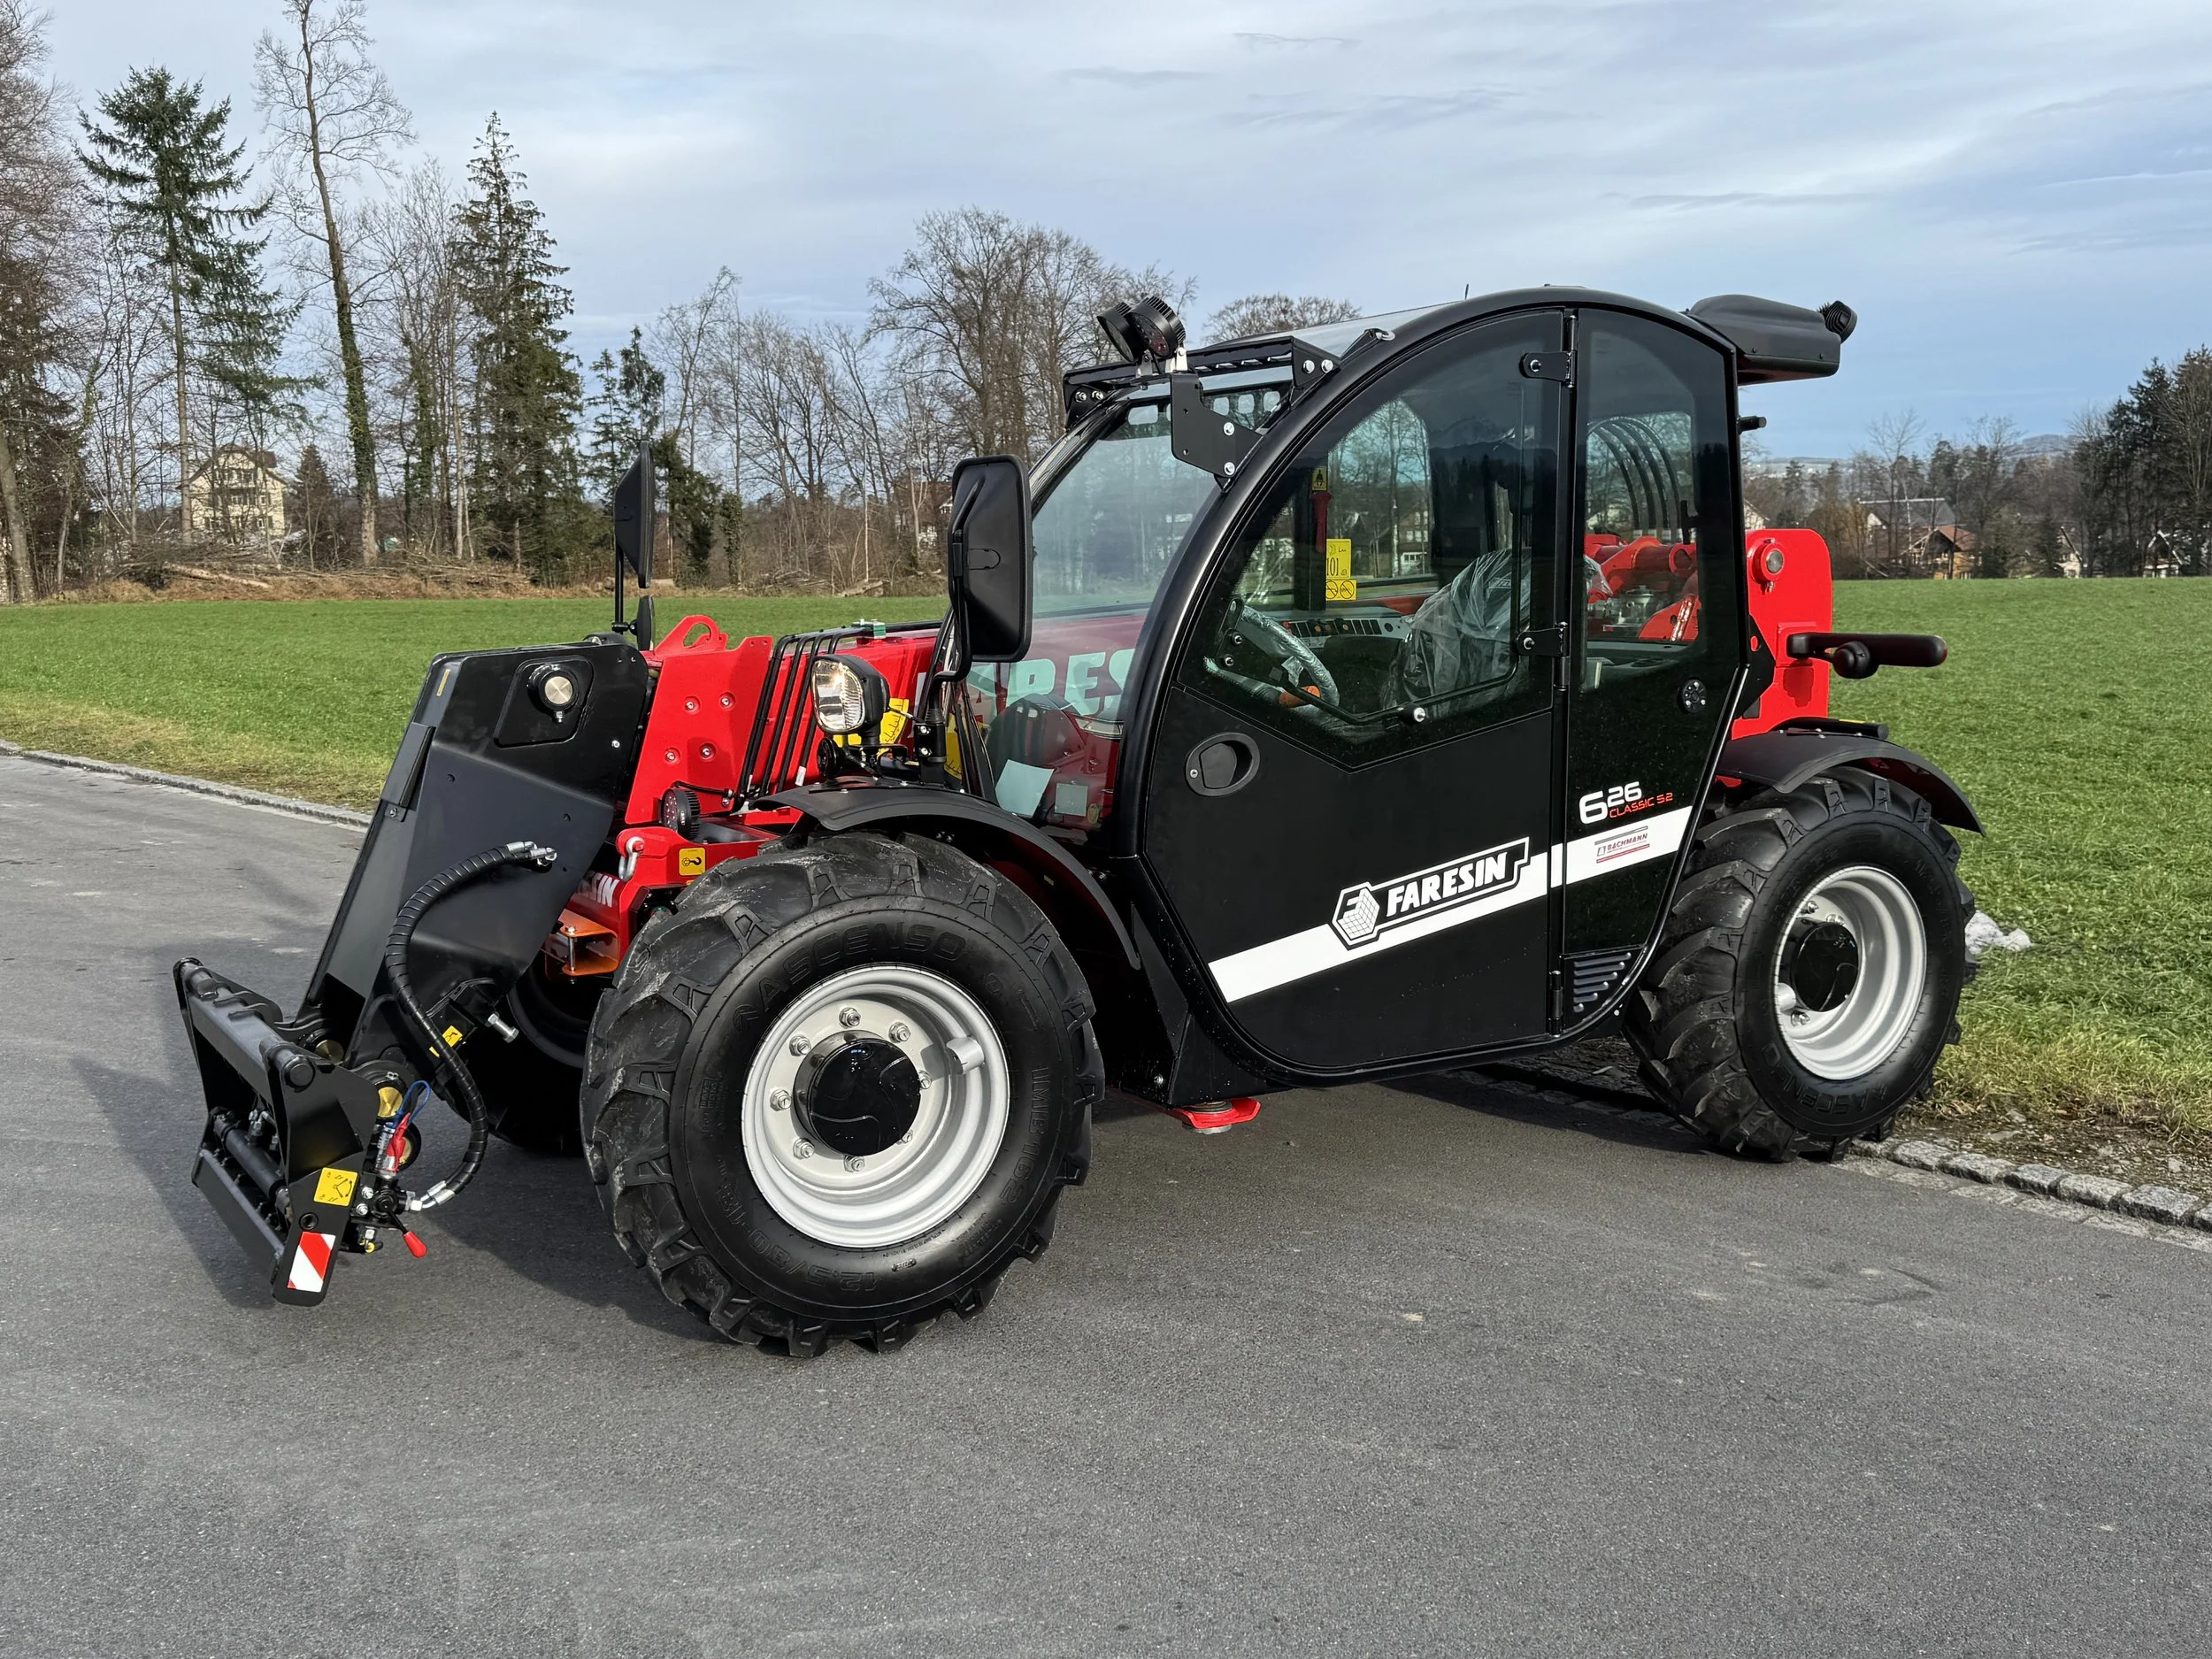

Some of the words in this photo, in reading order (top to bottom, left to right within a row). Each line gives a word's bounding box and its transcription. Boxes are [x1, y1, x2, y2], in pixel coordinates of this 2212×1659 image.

[1609, 797, 1655, 818] CLASSIC
[1607, 833, 1648, 851] BACHMANN
[1386, 851, 1508, 918] FARESIN
[759, 923, 966, 1006] ASCENSO
